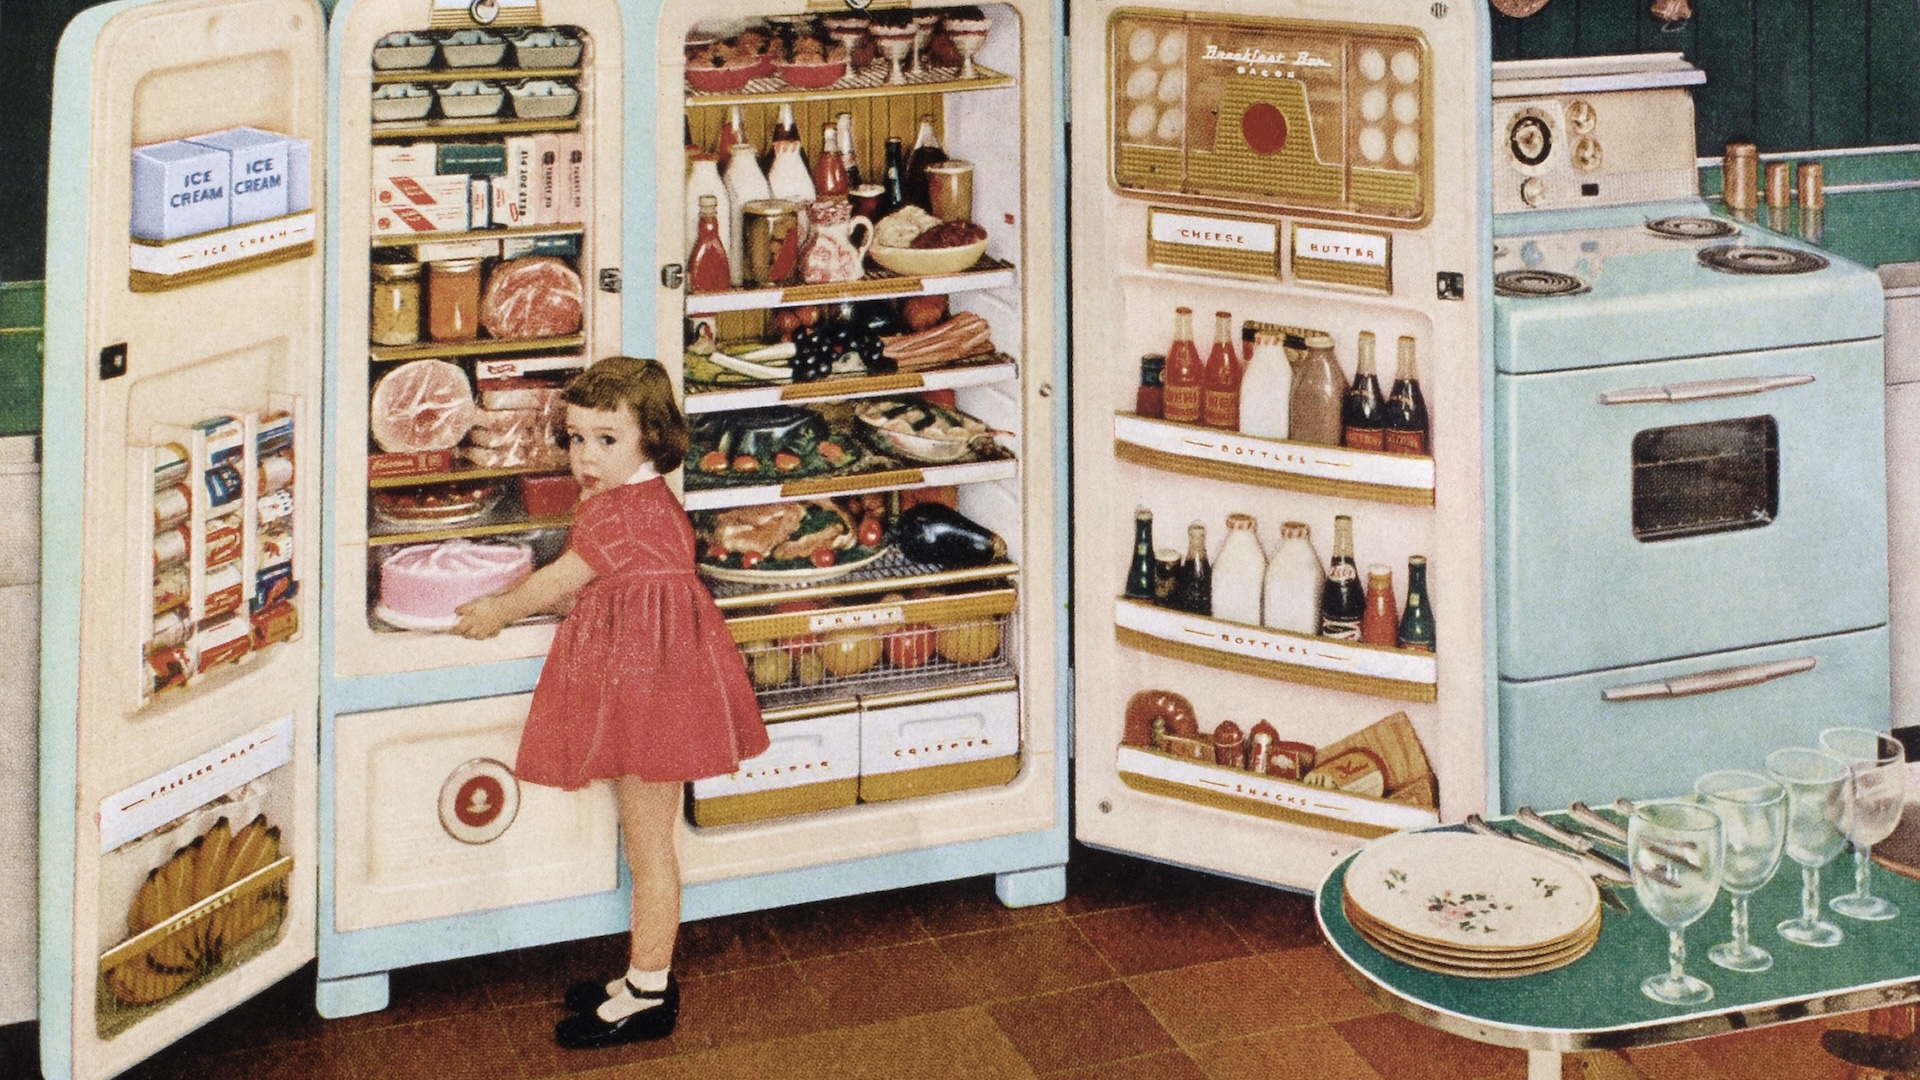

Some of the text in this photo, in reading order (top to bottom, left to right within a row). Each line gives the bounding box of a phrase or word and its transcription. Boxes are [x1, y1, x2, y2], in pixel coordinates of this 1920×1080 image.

[1237, 66, 1295, 79] BACON
[245, 158, 273, 174] ICE
[184, 170, 213, 188] ICE
[234, 174, 281, 195] CREAM
[169, 186, 223, 208] CREAM
[204, 231, 287, 256] ICE CREAM
[1181, 229, 1244, 244] CHEESE
[1310, 243, 1374, 259] BUTTER
[1221, 444, 1305, 464] BOTTLES
[818, 611, 894, 625] FRUIT
[1221, 633, 1308, 655] BOTTLES
[895, 738, 989, 757] CRISPER
[151, 743, 255, 798] FREEZER WRAP
[1236, 784, 1307, 807] SNACKS
